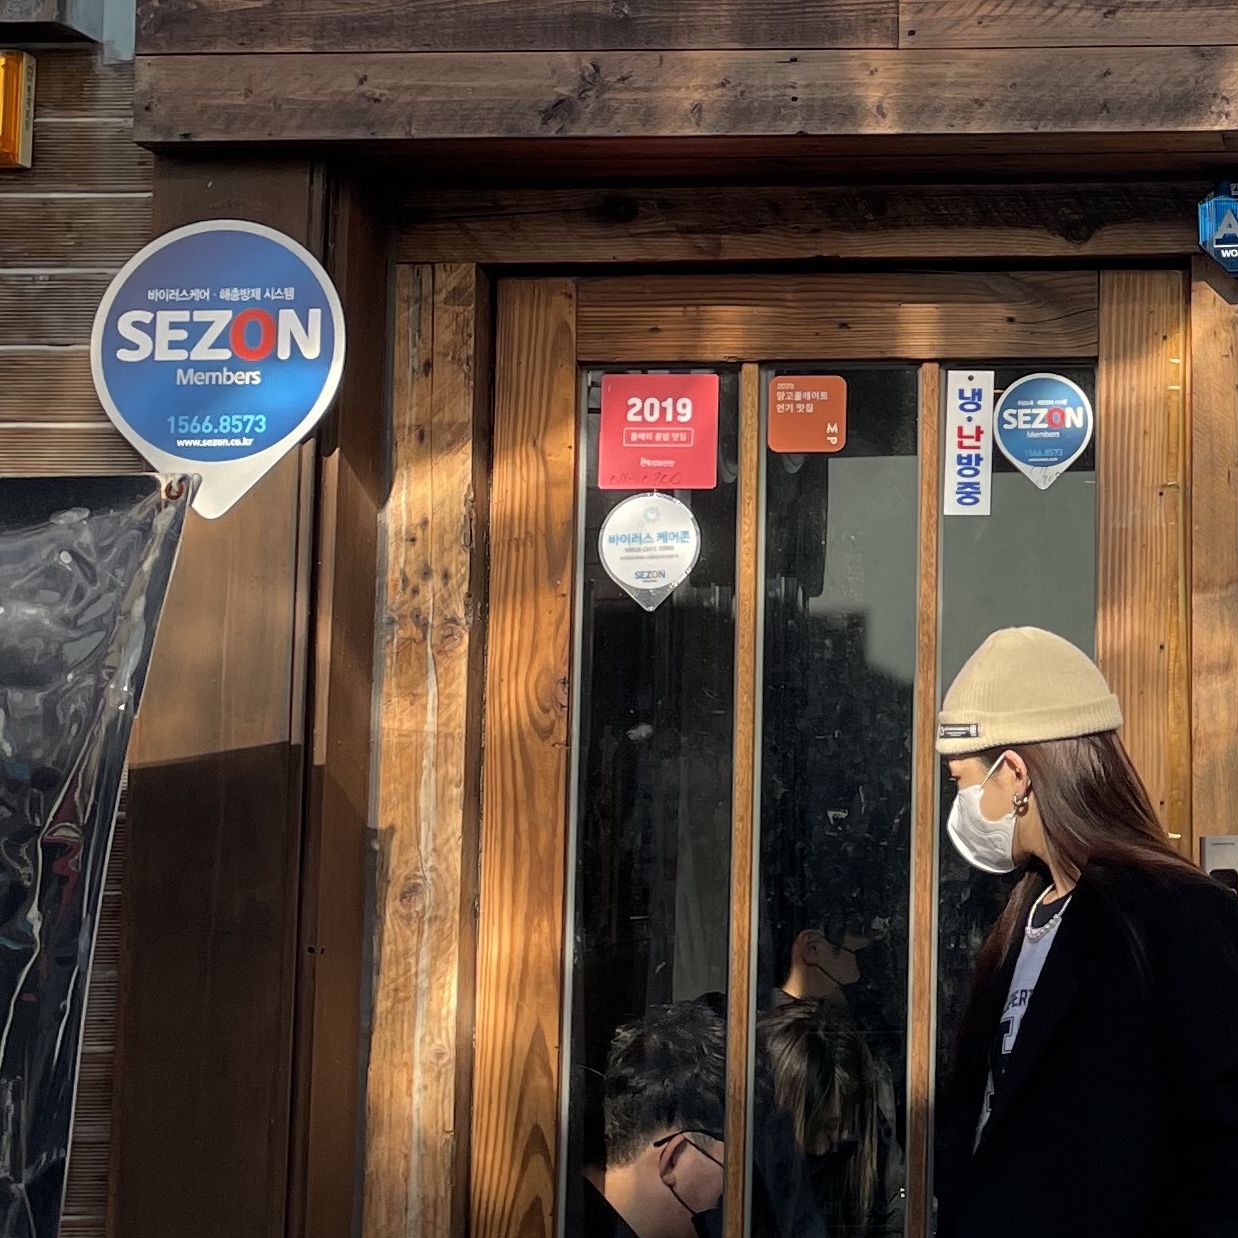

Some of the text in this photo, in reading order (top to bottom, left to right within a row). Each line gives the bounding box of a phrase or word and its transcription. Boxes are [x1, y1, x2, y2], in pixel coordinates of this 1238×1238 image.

[147, 287, 295, 302] 바이러스케어 해충방제 시스템
[116, 308, 322, 362] SEZON
[176, 367, 262, 386] Members
[626, 397, 693, 422] 2019
[776, 403, 814, 413] 인기 맛집
[167, 415, 267, 434] 1566.8573
[1002, 406, 1084, 430] SEZON
[176, 437, 254, 447] www.sezon.co.kr
[608, 530, 691, 546] 바이러스 케어존
[634, 570, 666, 580] SEZON
